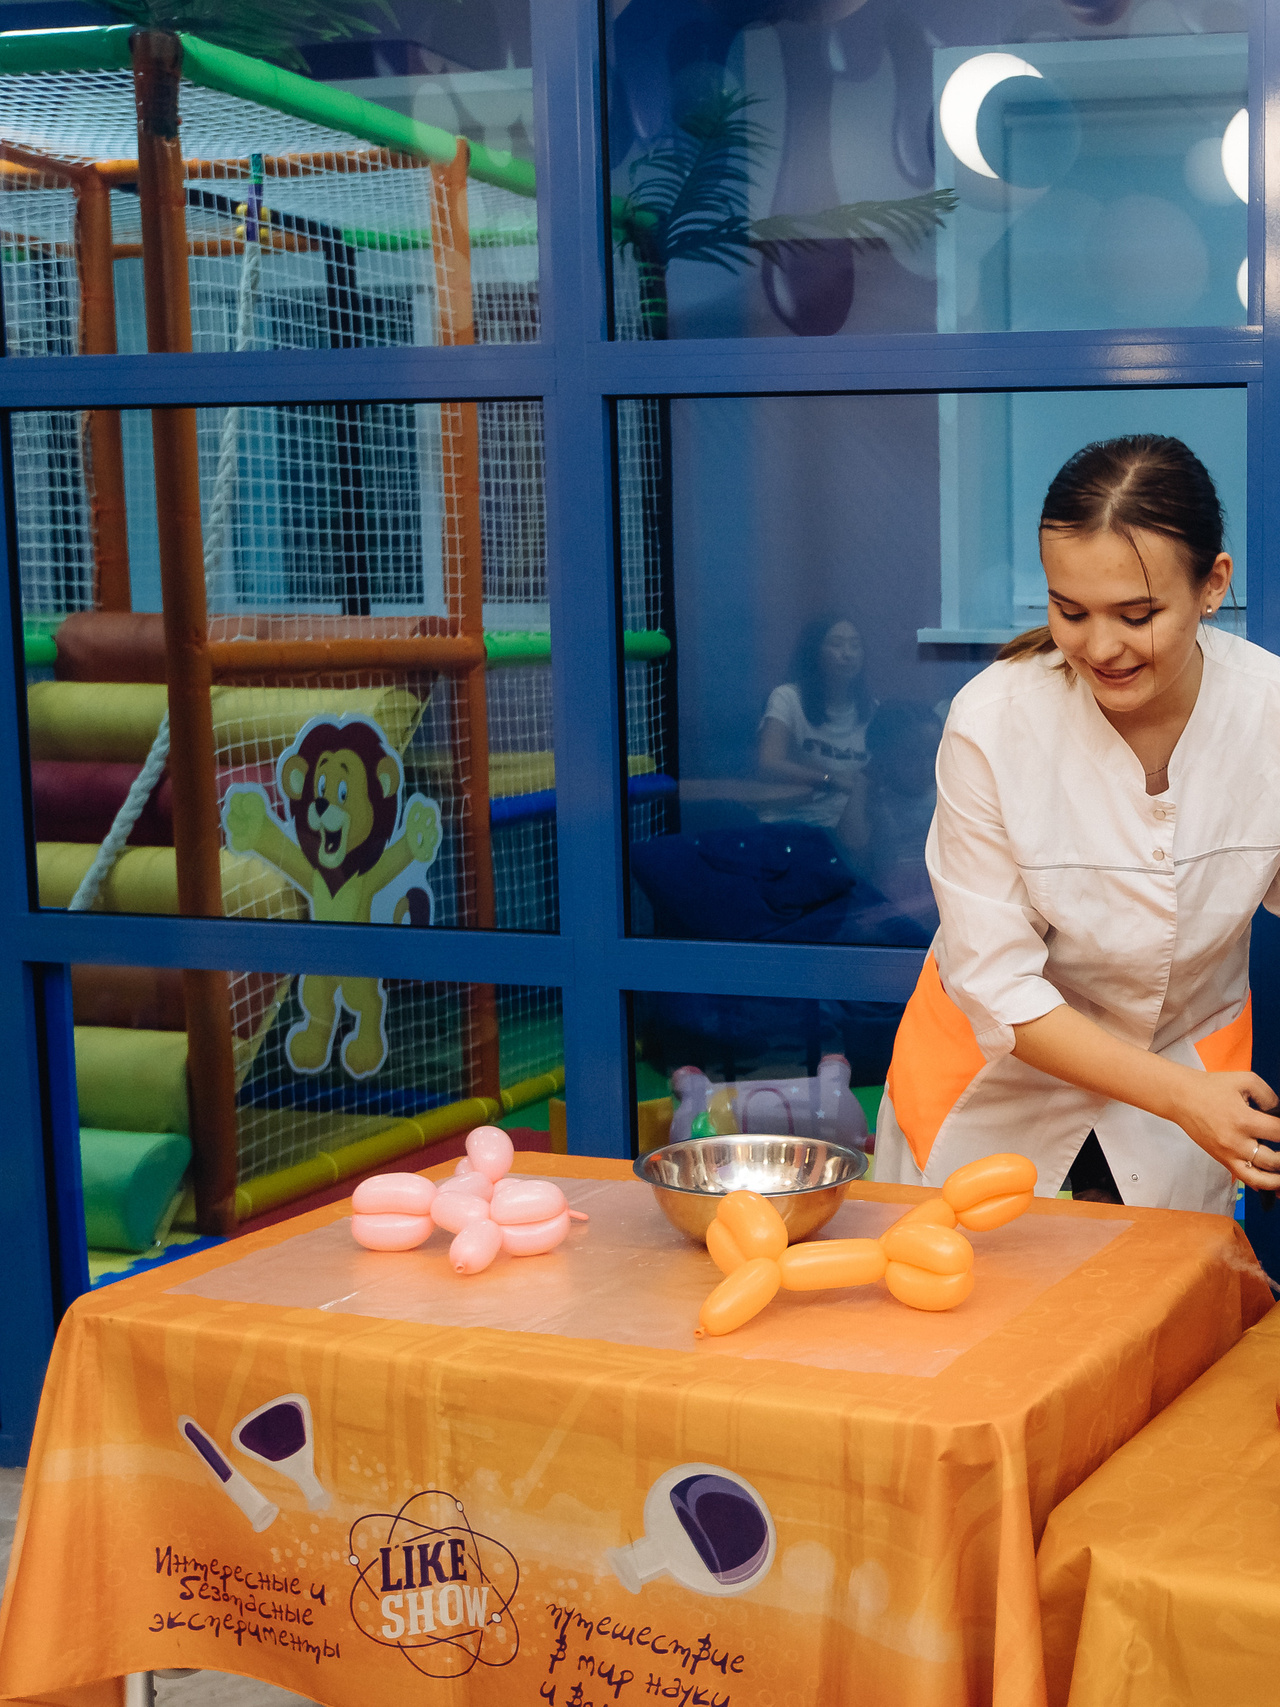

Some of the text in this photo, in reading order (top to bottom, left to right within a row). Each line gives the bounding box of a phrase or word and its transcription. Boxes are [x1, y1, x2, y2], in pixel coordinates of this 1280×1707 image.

[155, 1545, 326, 1606] Интересные и
[379, 1538, 468, 1592] LIKE
[149, 1611, 341, 1664] эксперименты
[381, 1584, 490, 1639] SHOW
[577, 1655, 635, 1699] мир
